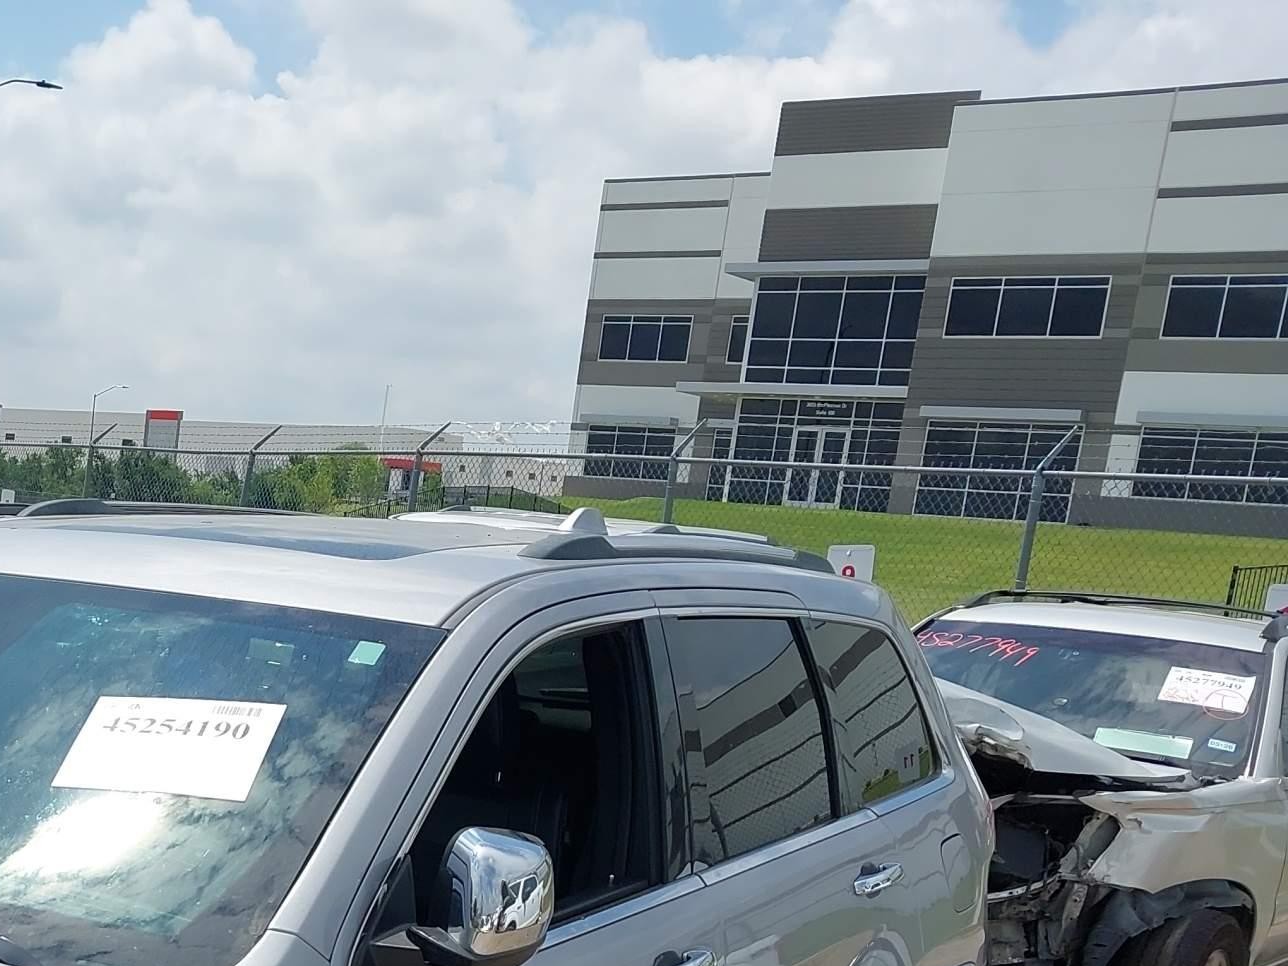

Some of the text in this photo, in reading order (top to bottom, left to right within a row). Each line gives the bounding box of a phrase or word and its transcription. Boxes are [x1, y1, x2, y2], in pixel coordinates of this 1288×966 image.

[917, 628, 1040, 667] 45277949
[1176, 675, 1242, 690] 45277949
[103, 716, 250, 740] 45254190
